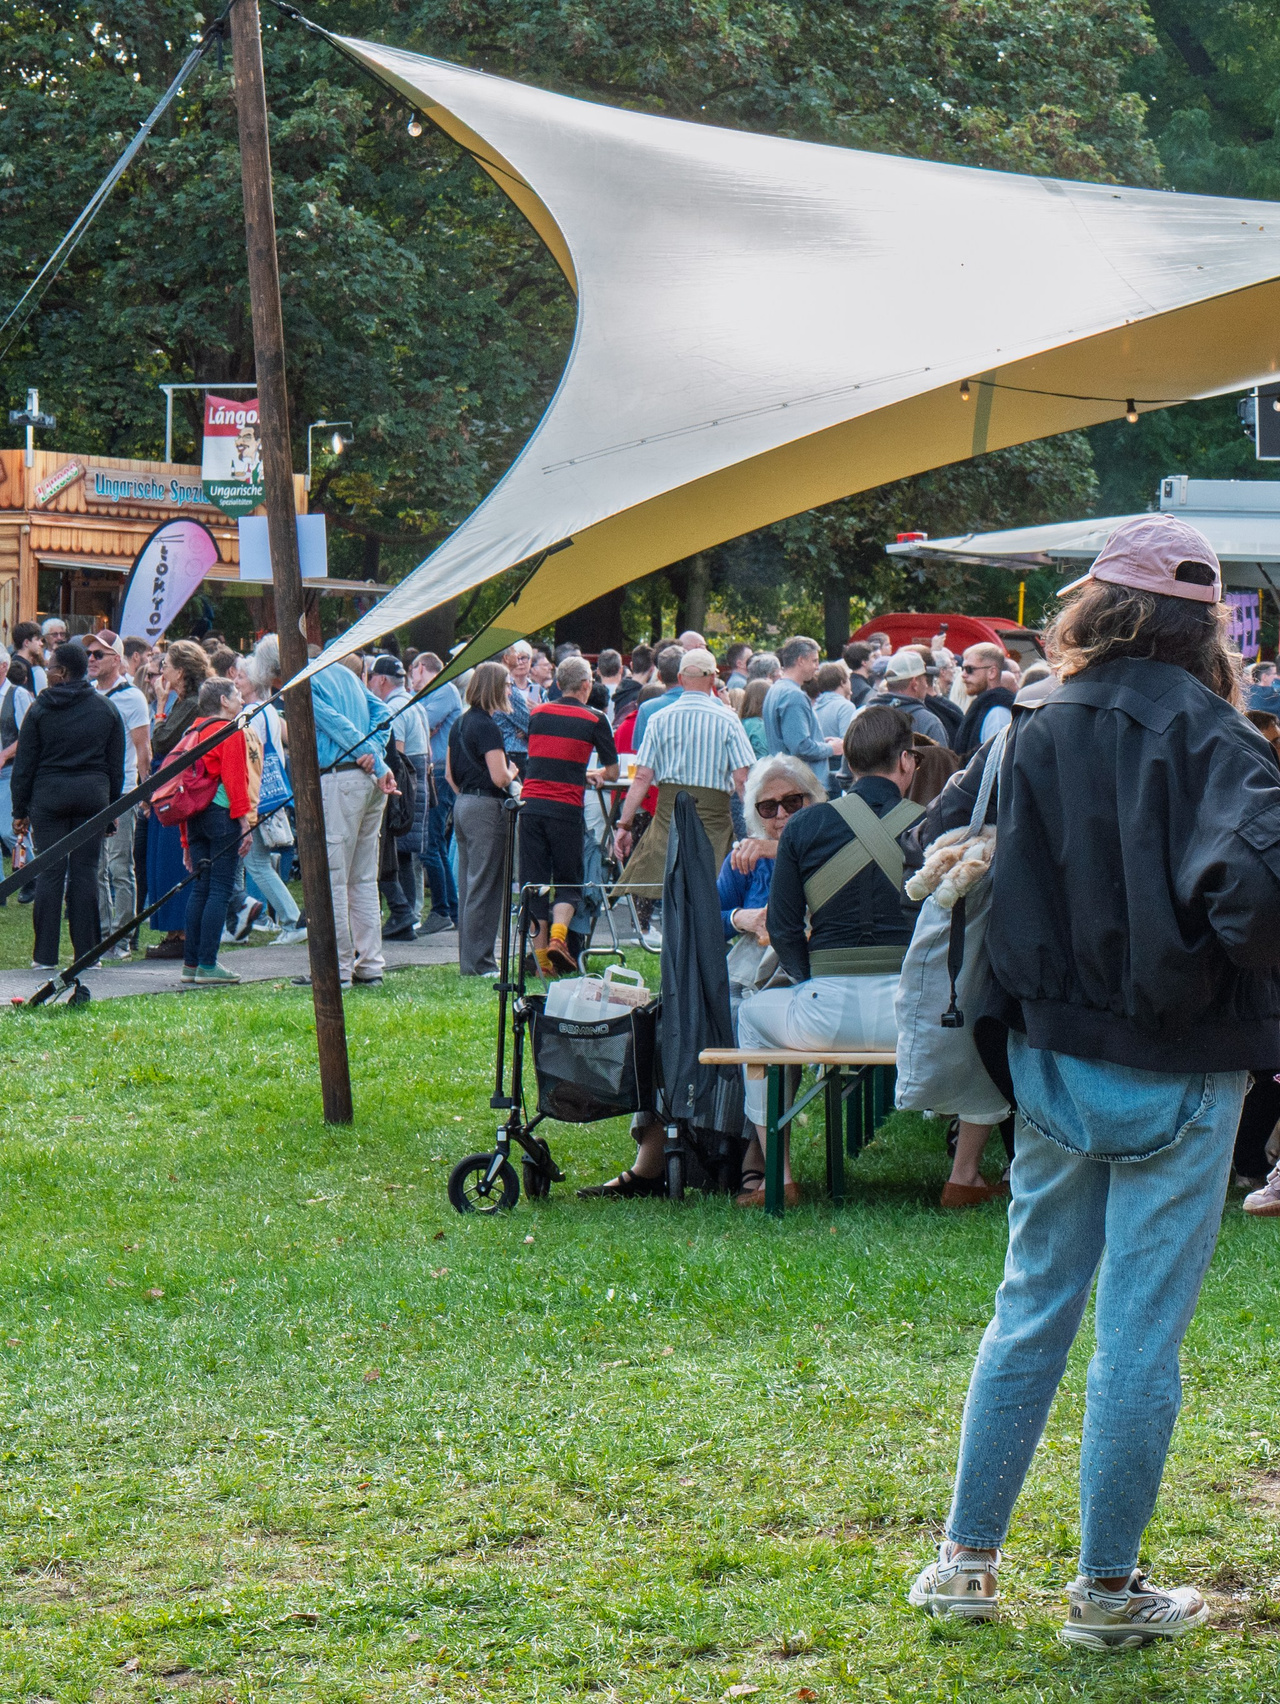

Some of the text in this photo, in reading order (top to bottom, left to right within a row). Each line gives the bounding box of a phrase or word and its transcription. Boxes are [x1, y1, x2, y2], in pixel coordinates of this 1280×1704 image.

[208, 405, 260, 430] Lángo
[95, 473, 165, 502] Ungarische
[210, 484, 263, 499] Ungarische
